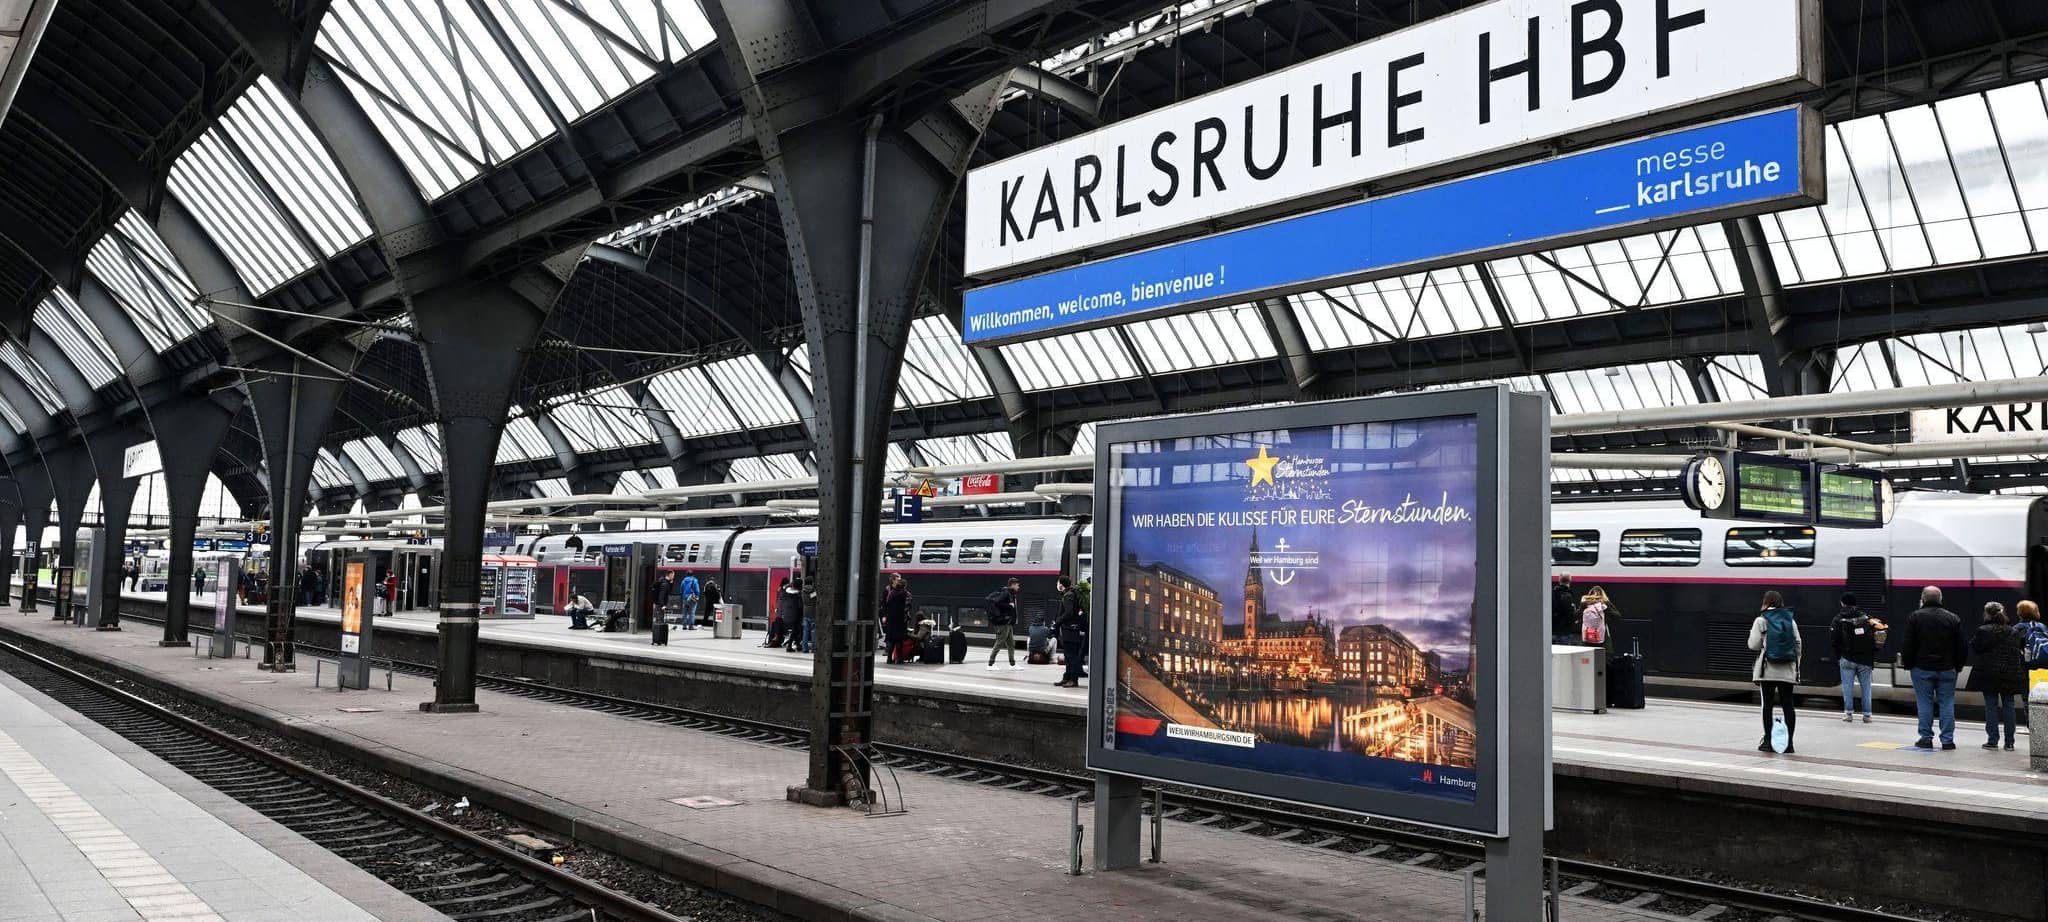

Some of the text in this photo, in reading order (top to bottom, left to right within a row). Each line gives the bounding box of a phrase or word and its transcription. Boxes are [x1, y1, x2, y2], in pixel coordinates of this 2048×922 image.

[1000, 0, 1705, 246] KARLSRUHE HBF
[1637, 141, 1726, 177] messe
[1637, 160, 1781, 206] karlsruhe
[970, 304, 1054, 332] Willkommen,
[1058, 294, 1126, 316] welcome,
[1131, 272, 1214, 302] bienvenue
[901, 496, 913, 517] E
[1132, 491, 1472, 528] WIR HABEN DIE KULISSE FÜR EURE Sternstunden.
[246, 532, 269, 543] 3 D
[1273, 555, 1304, 566] Hamburg
[1168, 726, 1253, 745] WEILWIRHAMBURGSIND.DE
[1439, 775, 1477, 791] Hamburg
